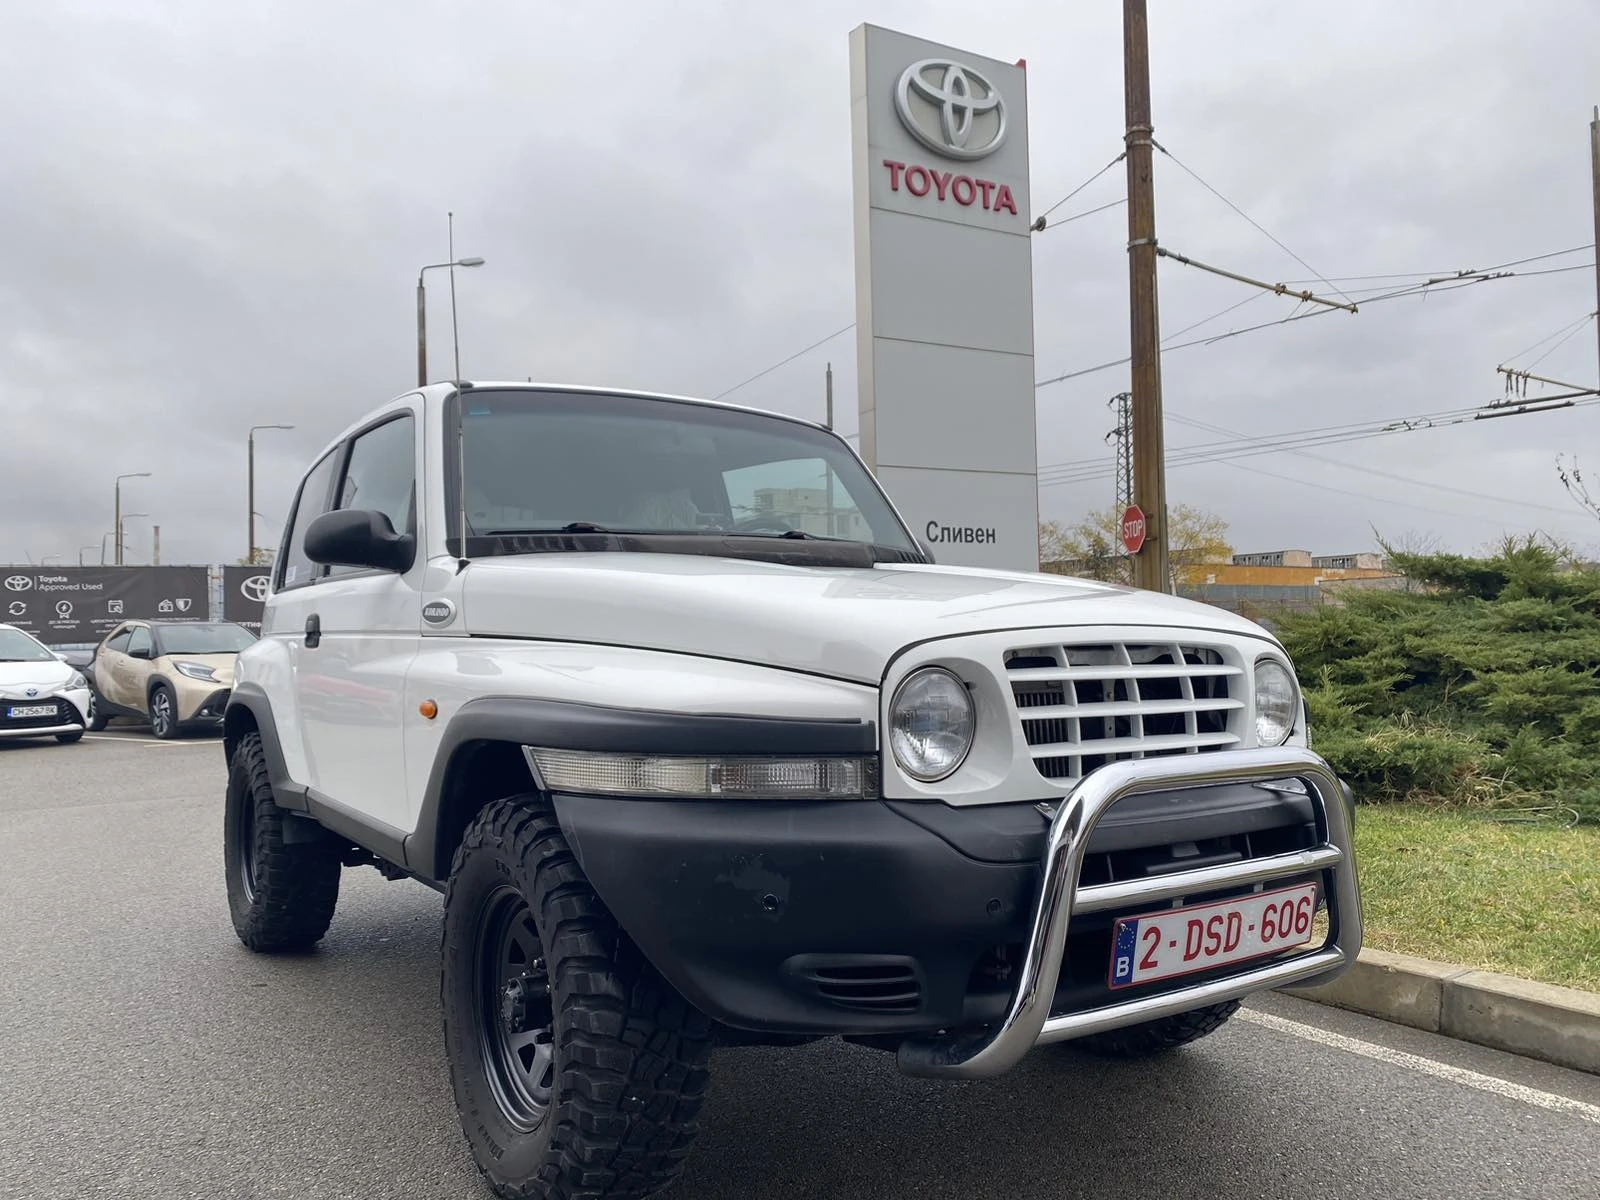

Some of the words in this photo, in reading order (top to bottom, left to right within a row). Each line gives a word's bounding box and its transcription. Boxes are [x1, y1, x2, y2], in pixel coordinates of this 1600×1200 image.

[882, 159, 1018, 216] TOYOTA
[926, 520, 996, 544] Сливен
[1124, 519, 1143, 539] STOP
[38, 575, 68, 585] Toyota
[38, 583, 80, 592] Approved
[1116, 956, 1131, 977] B
